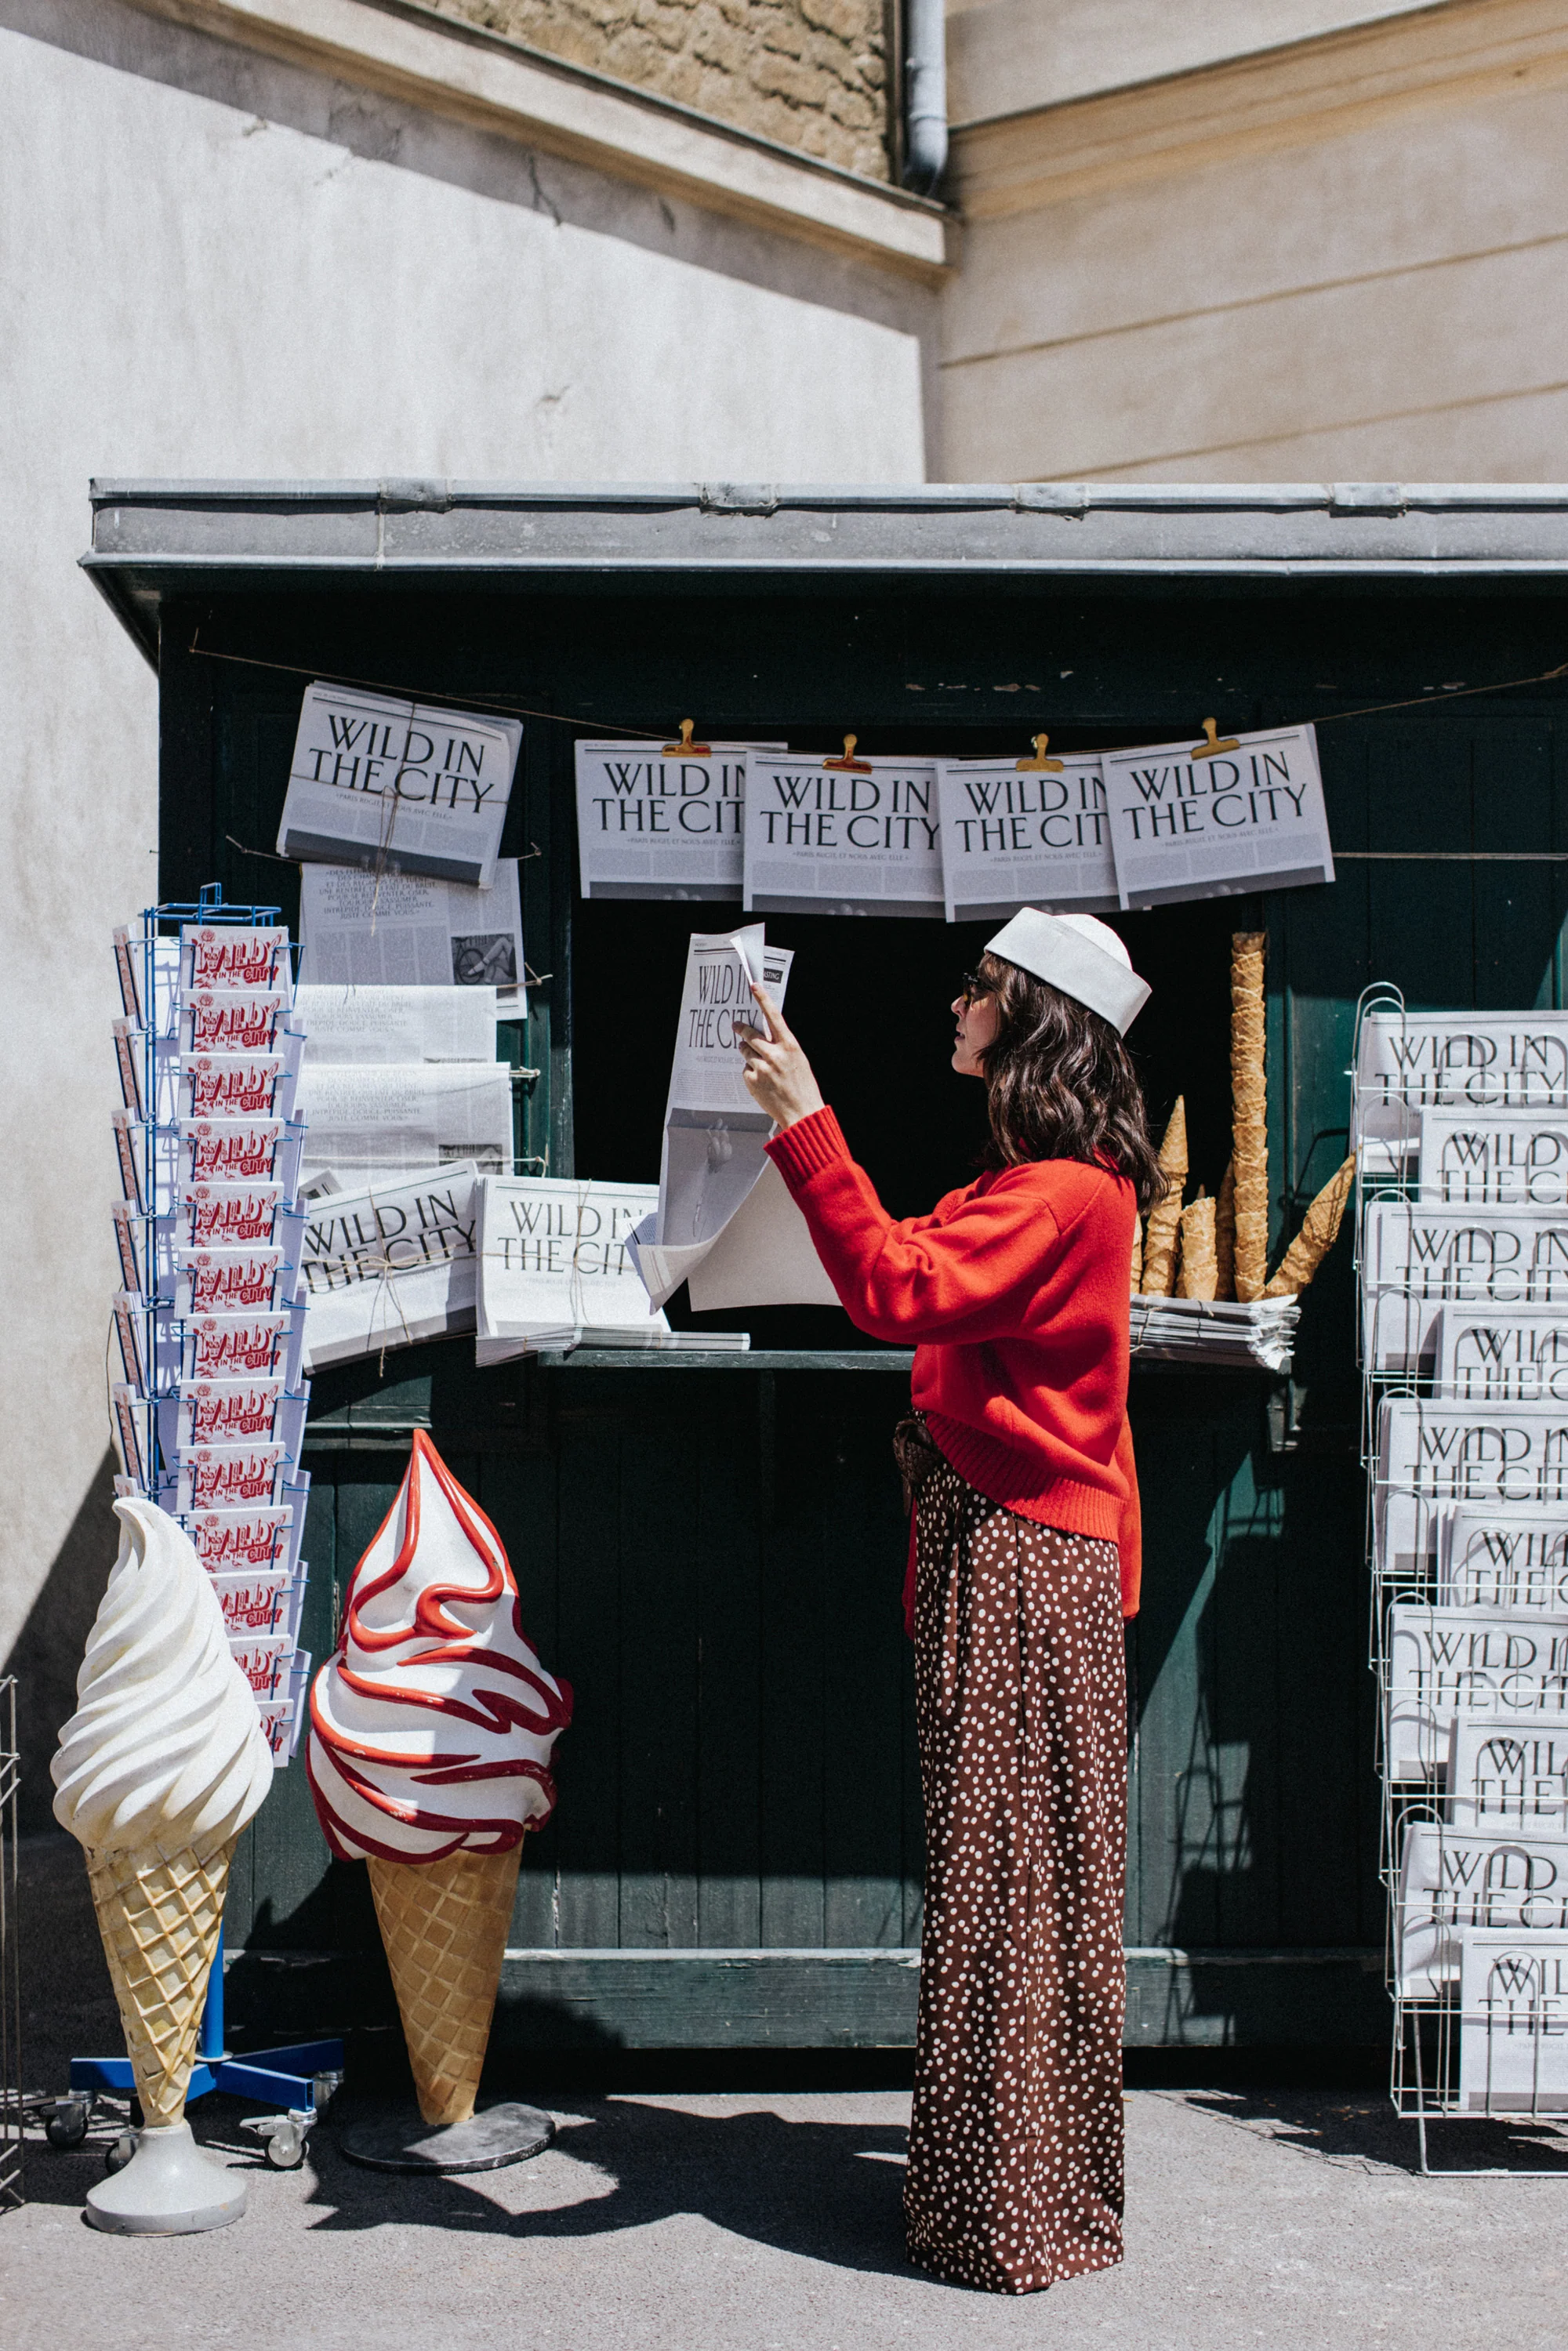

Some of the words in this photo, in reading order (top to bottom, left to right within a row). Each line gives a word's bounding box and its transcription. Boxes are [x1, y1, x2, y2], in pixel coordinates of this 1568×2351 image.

[328, 714, 434, 764] WILD
[443, 738, 485, 777] IN
[309, 747, 384, 794] THE
[394, 767, 495, 814] CITY
[602, 763, 710, 797] WILD
[1130, 760, 1240, 802] WILD
[1249, 750, 1290, 785] IN
[773, 775, 880, 811] WILD
[891, 780, 931, 815] IN
[964, 779, 1069, 815] WILD
[1122, 800, 1205, 840] THE
[1212, 784, 1307, 827] CITY
[592, 798, 670, 832] THE
[678, 800, 745, 834] CIT
[760, 811, 838, 847] THE
[847, 815, 940, 851] CITY
[955, 816, 1032, 852] THE
[1040, 812, 1109, 847] CIT
[219, 971, 227, 979] IN
[228, 969, 241, 978] THE
[243, 965, 279, 985] CITY
[699, 964, 734, 1004] WILD
[763, 971, 780, 980] STING
[217, 1035, 225, 1043] IN
[227, 1033, 240, 1043] THE
[241, 1029, 278, 1048] CITY
[688, 1009, 714, 1048] THE
[1388, 1035, 1497, 1069] WILD
[1510, 1034, 1548, 1067] IN
[216, 1099, 223, 1108] IN
[225, 1097, 238, 1106] THE
[240, 1093, 276, 1112] CITY
[1374, 1072, 1454, 1106] THE
[1465, 1071, 1563, 1105] CITY
[216, 1163, 223, 1172] IN
[225, 1162, 238, 1171] THE
[240, 1157, 276, 1177] CITY
[1450, 1133, 1561, 1166] WILD
[1436, 1170, 1517, 1203] THE
[212, 1227, 220, 1235] IN
[222, 1225, 235, 1235] THE
[237, 1221, 273, 1241] CITY
[304, 1205, 407, 1257] WILD
[414, 1189, 459, 1228] IN
[510, 1201, 602, 1238] WILD
[301, 1247, 380, 1296] THE
[385, 1218, 476, 1270] CITY
[497, 1236, 564, 1274] THE
[572, 1242, 641, 1276] CIT
[1412, 1228, 1521, 1263] WILD
[224, 1291, 238, 1301] THE
[240, 1286, 276, 1305] CITY
[1396, 1265, 1476, 1301] THE
[220, 1358, 228, 1366] IN
[230, 1355, 243, 1365] THE
[245, 1351, 281, 1370] CITY
[1457, 1366, 1538, 1401] THE
[215, 1423, 223, 1431] IN
[224, 1421, 238, 1430] THE
[239, 1416, 276, 1435] CITY
[1418, 1426, 1531, 1461] WILD
[216, 1488, 223, 1497] IN
[225, 1486, 238, 1495] THE
[240, 1480, 276, 1499] CITY
[1404, 1464, 1486, 1500] THE
[1496, 1466, 1568, 1500] CIT
[232, 1551, 245, 1559] THE
[247, 1544, 283, 1563] CITY
[1482, 1531, 1568, 1567] WIL
[220, 1585, 271, 1618] ILD
[1467, 1569, 1546, 1605] THE
[231, 1615, 245, 1624] THE
[246, 1608, 283, 1627] CITY
[1424, 1631, 1537, 1670] WILD
[1549, 1637, 1568, 1672] I
[250, 1673, 281, 1691] ITY
[1409, 1669, 1490, 1707] THE
[1500, 1673, 1568, 1710] CIT
[1486, 1739, 1566, 1776] WIL
[1471, 1779, 1557, 1815] THE
[1440, 1849, 1558, 1891] WILD
[1422, 1888, 1508, 1928] THE
[1519, 1895, 1568, 1928] CI
[1492, 1958, 1568, 1995] WIL
[1478, 1998, 1565, 2036] THE
